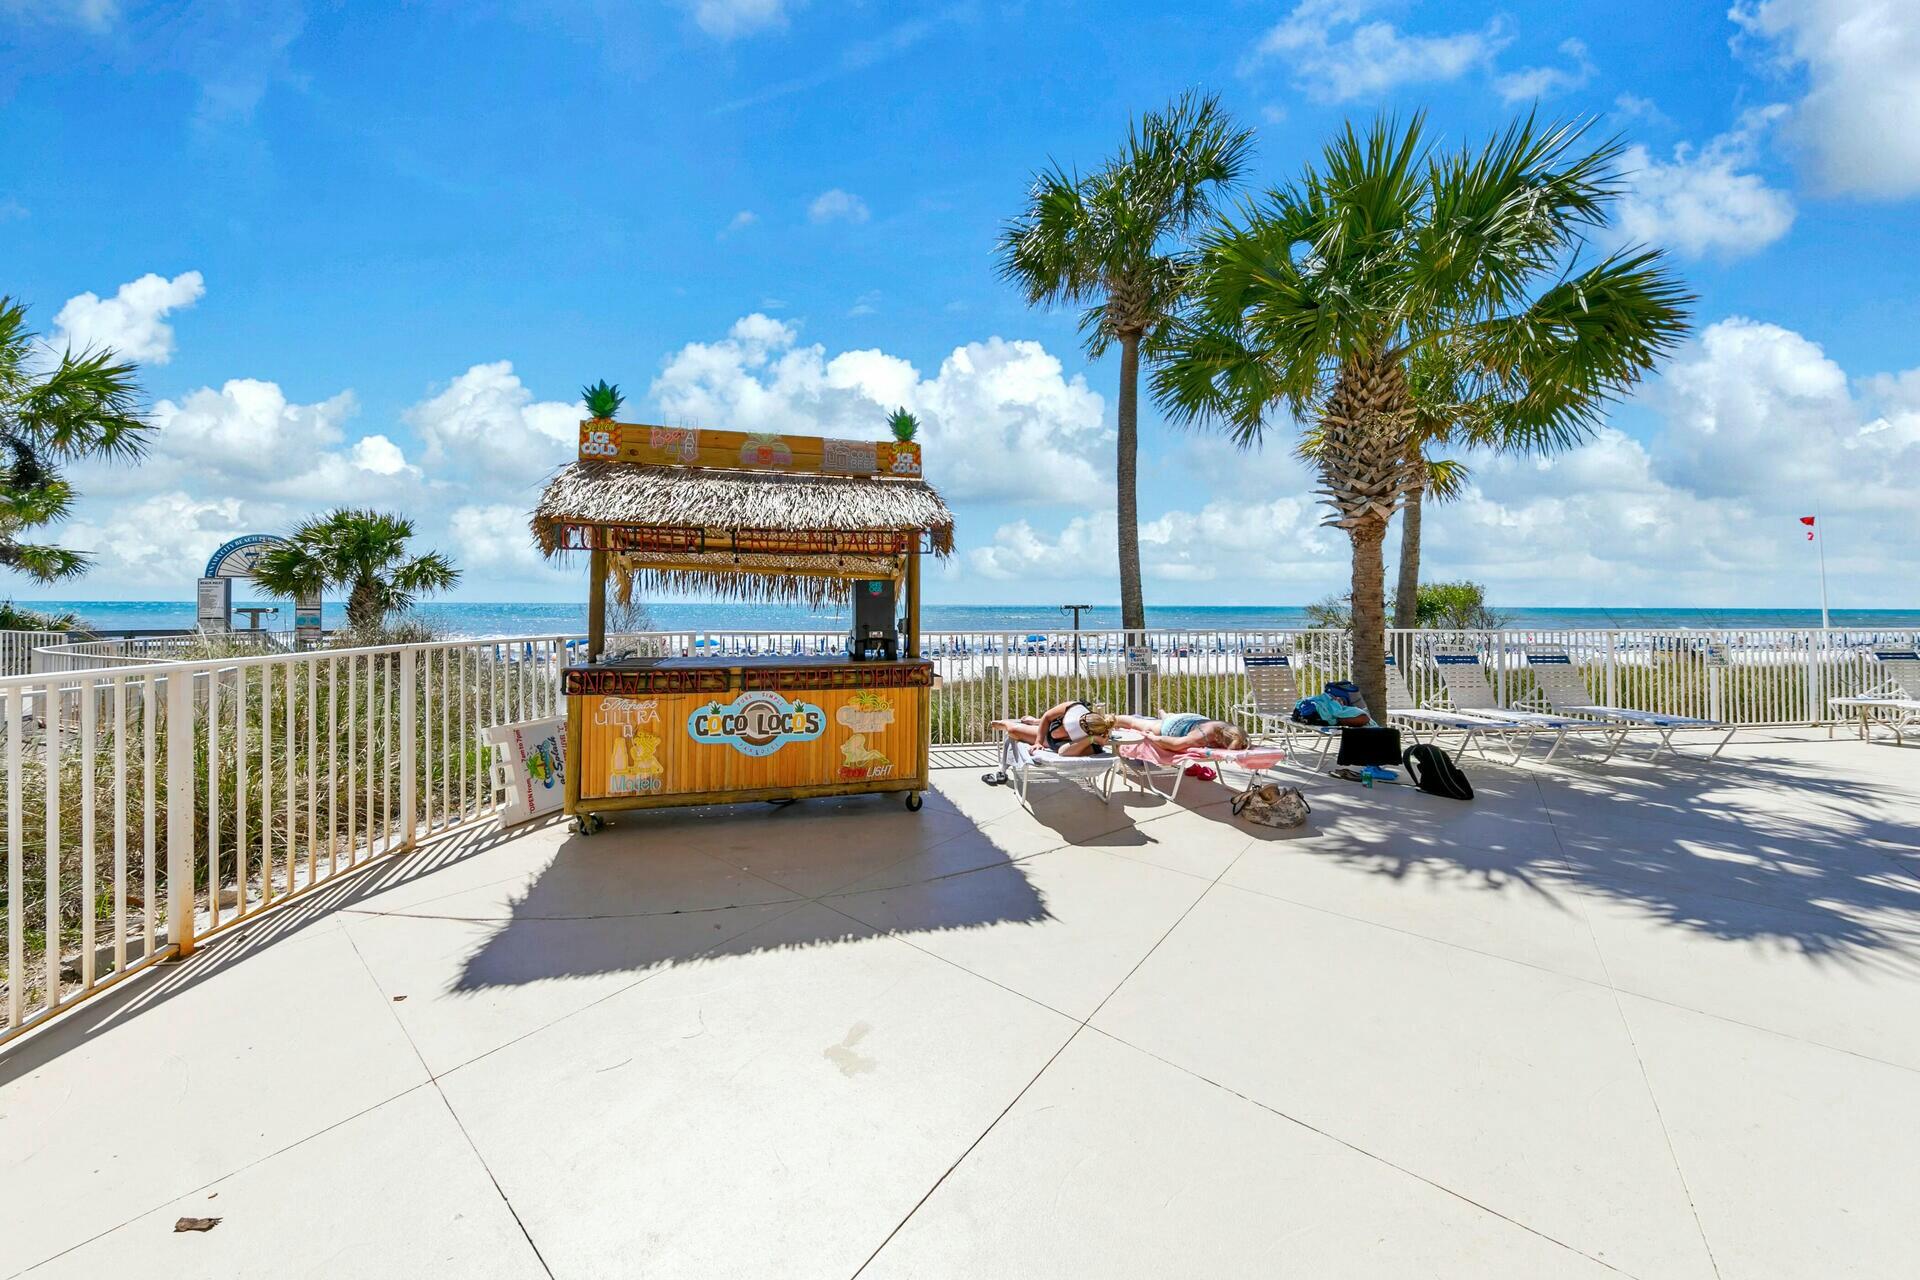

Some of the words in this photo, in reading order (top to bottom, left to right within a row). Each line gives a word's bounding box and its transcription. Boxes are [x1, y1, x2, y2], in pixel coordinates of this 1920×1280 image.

[590, 432, 609, 444] ICE
[581, 443, 618, 456] COLD
[851, 450, 876, 459] COLD
[897, 453, 913, 464] ICE
[891, 463, 921, 474] COLD
[235, 536, 258, 546] BEACH
[567, 671, 640, 695] SNOW
[650, 669, 725, 693] CONES
[745, 667, 855, 690] PINEAPPLE
[861, 664, 930, 689] DRINKS
[594, 710, 660, 725] ULTRA
[695, 714, 748, 736] COCO
[757, 712, 820, 736] LOCOS
[547, 736, 564, 772] Splash
[866, 764, 894, 778] LIGHT
